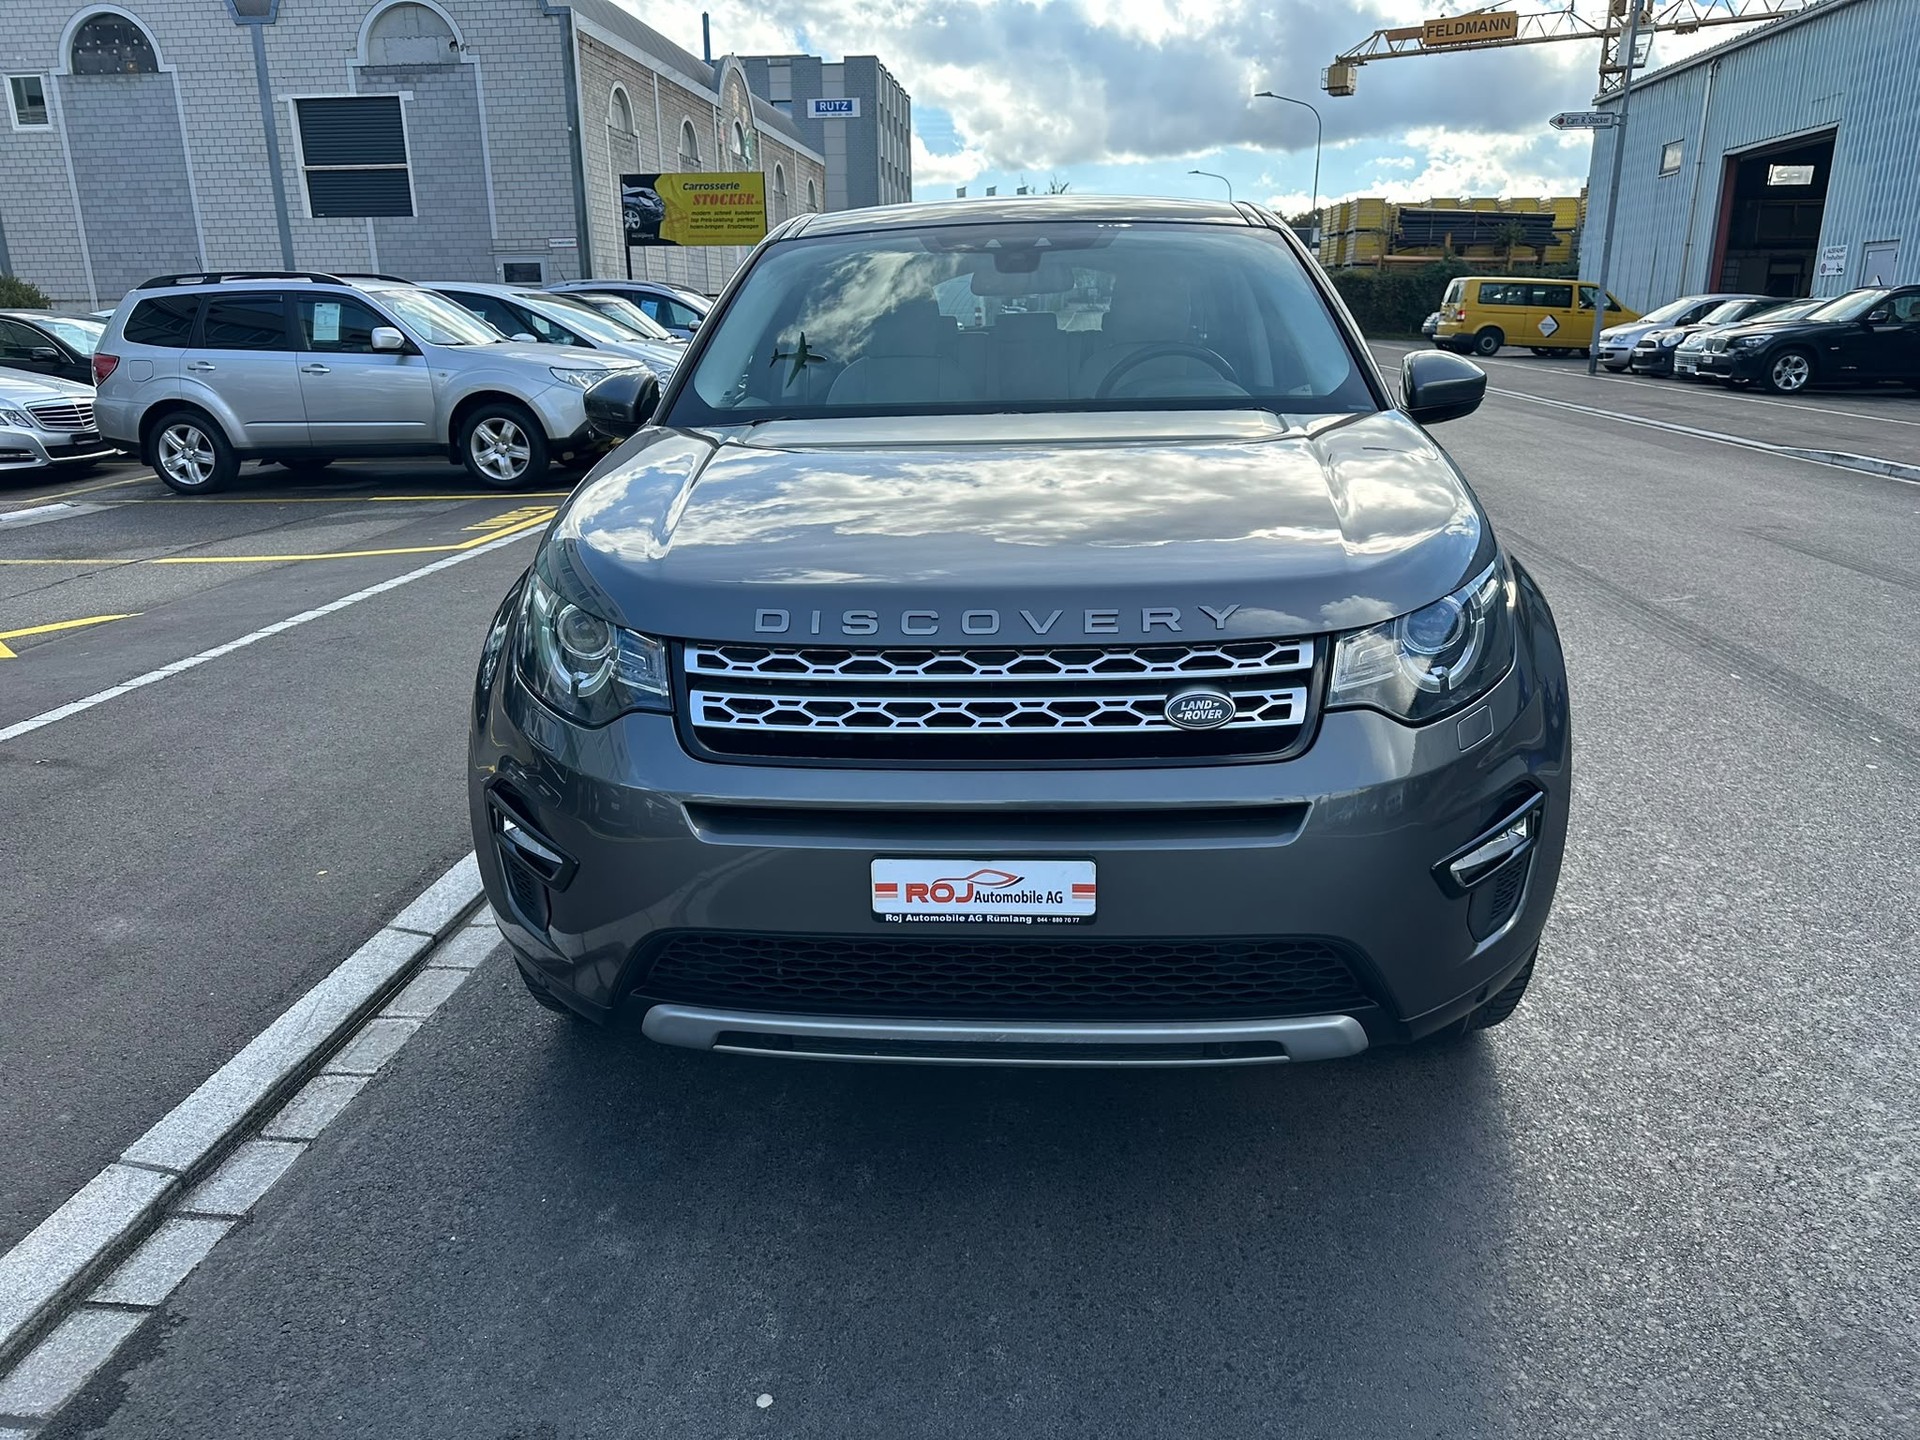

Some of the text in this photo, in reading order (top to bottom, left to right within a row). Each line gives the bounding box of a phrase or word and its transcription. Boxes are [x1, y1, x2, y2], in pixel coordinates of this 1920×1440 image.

[1426, 17, 1511, 38] FELDMANN
[820, 101, 848, 111] RUTZ
[682, 182, 740, 191] Carrosserie
[693, 193, 755, 206] STOCKER
[754, 604, 1241, 635] DISCOVERY
[1180, 700, 1212, 711] LAND
[1183, 709, 1223, 720] ROVER
[905, 883, 1063, 904] ROJ Automobile AG
[885, 913, 903, 923] Roj
[905, 914, 966, 922] Automobile
[967, 914, 983, 922] AG
[986, 914, 1032, 924] Rümlang
